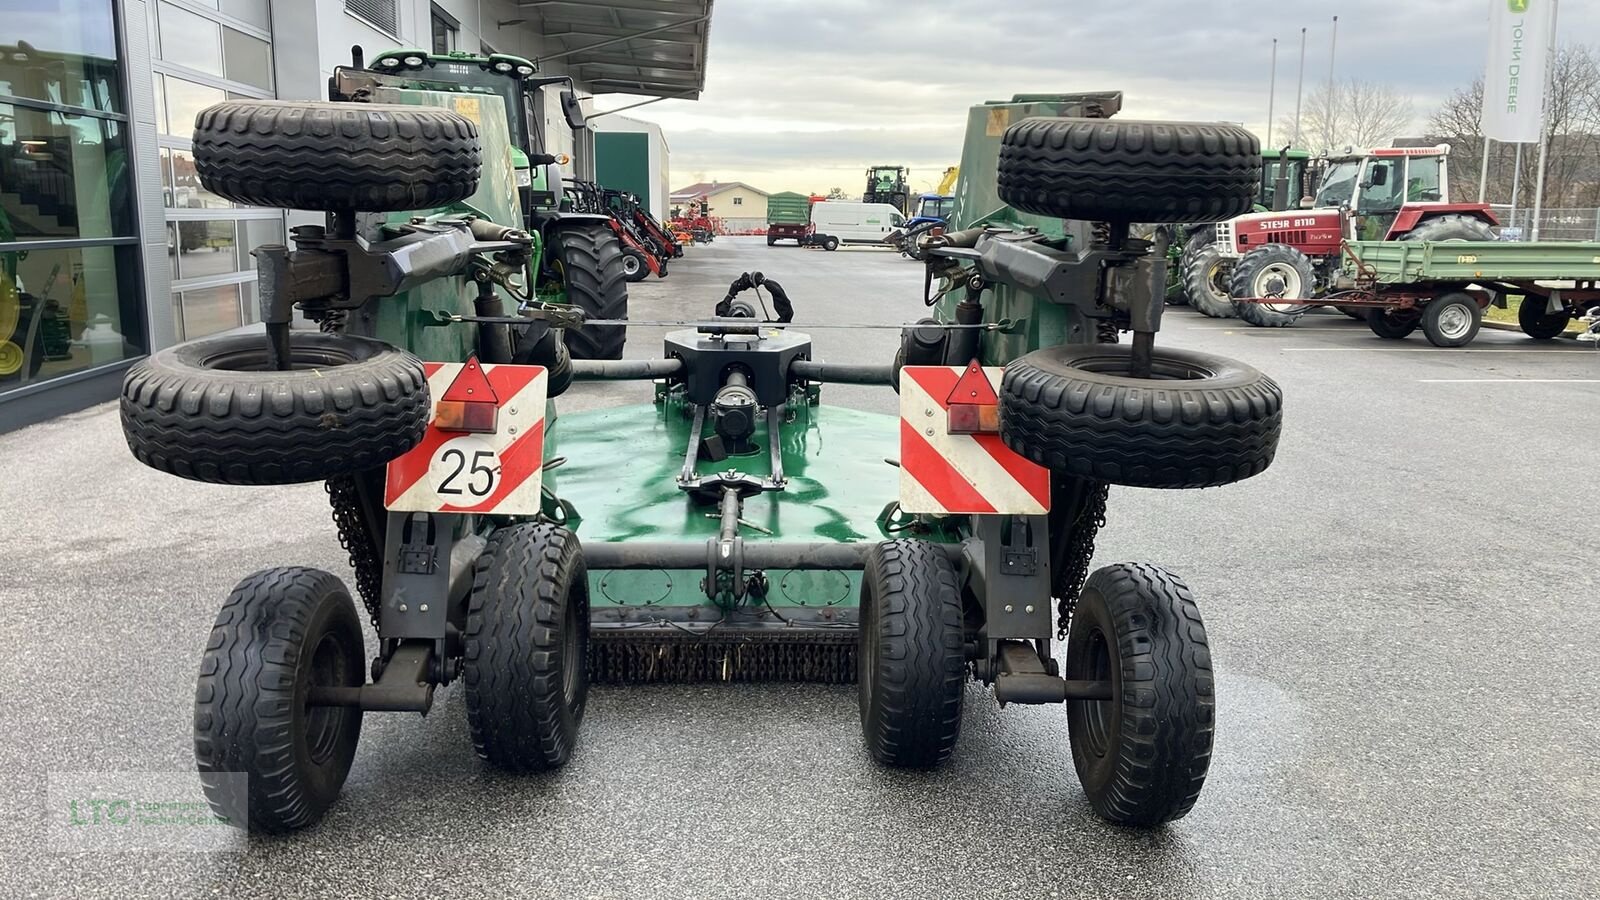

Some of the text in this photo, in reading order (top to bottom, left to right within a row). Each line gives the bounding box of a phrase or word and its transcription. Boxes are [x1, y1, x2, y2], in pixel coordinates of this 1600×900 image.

[1260, 218, 1316, 229] STEYR 8110
[436, 449, 494, 496] 25
